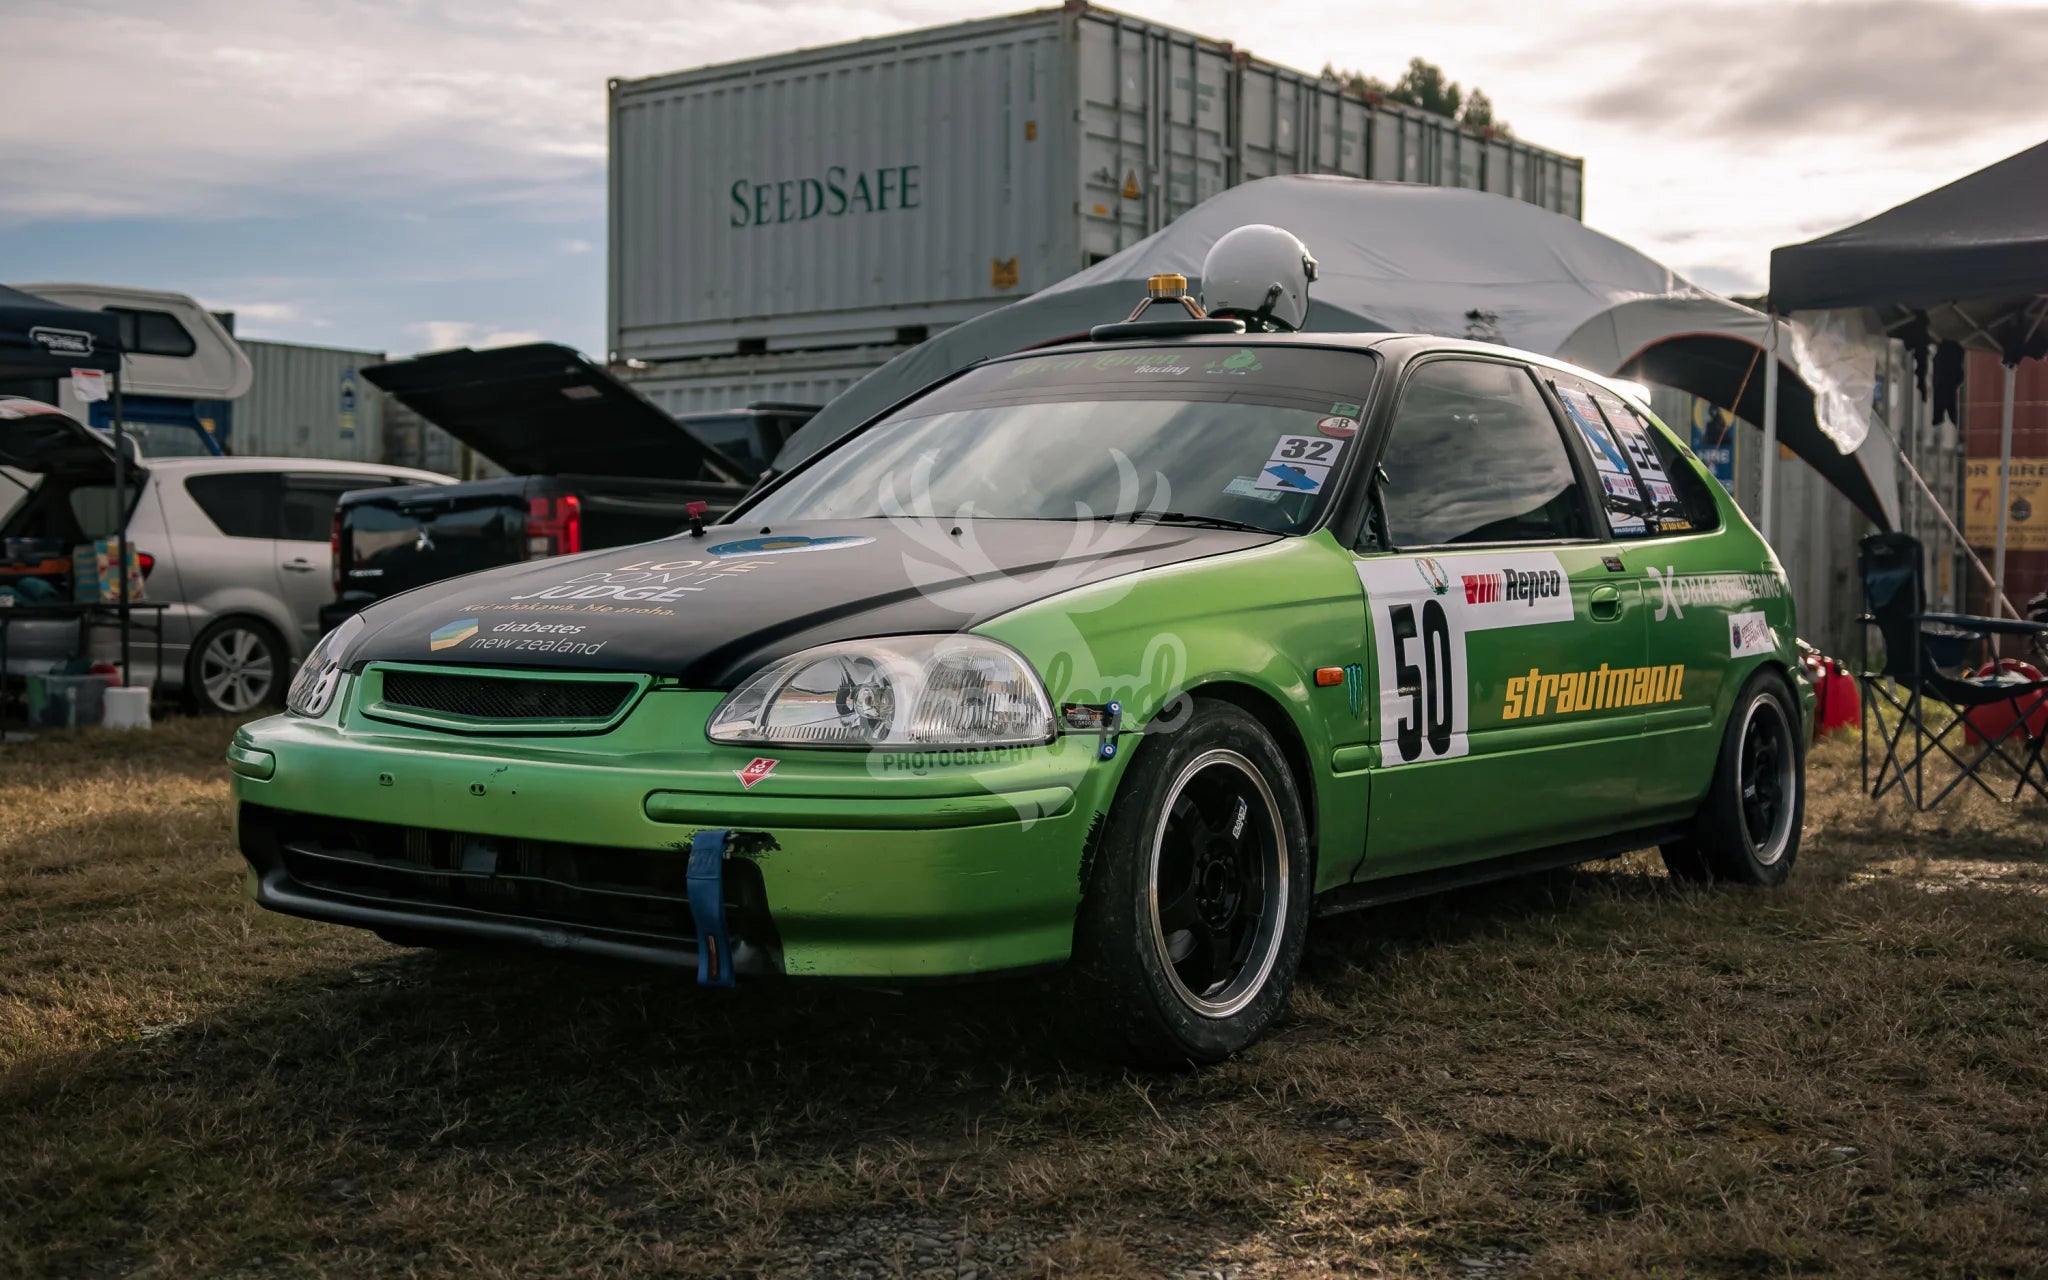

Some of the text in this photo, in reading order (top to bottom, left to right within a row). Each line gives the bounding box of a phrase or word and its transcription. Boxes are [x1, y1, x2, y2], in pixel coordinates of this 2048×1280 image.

[1135, 364, 1190, 375] Racing
[1281, 438, 1334, 461] 32
[615, 560, 777, 573] LOVE
[565, 572, 739, 585] DON'T
[1503, 568, 1560, 607] Repco
[510, 585, 706, 603] JUDGE
[493, 621, 587, 635] diabetes
[469, 637, 607, 656] new zealand
[1388, 599, 1453, 762] 50
[1502, 662, 1685, 720] strautmann
[750, 759, 770, 774] TOW
